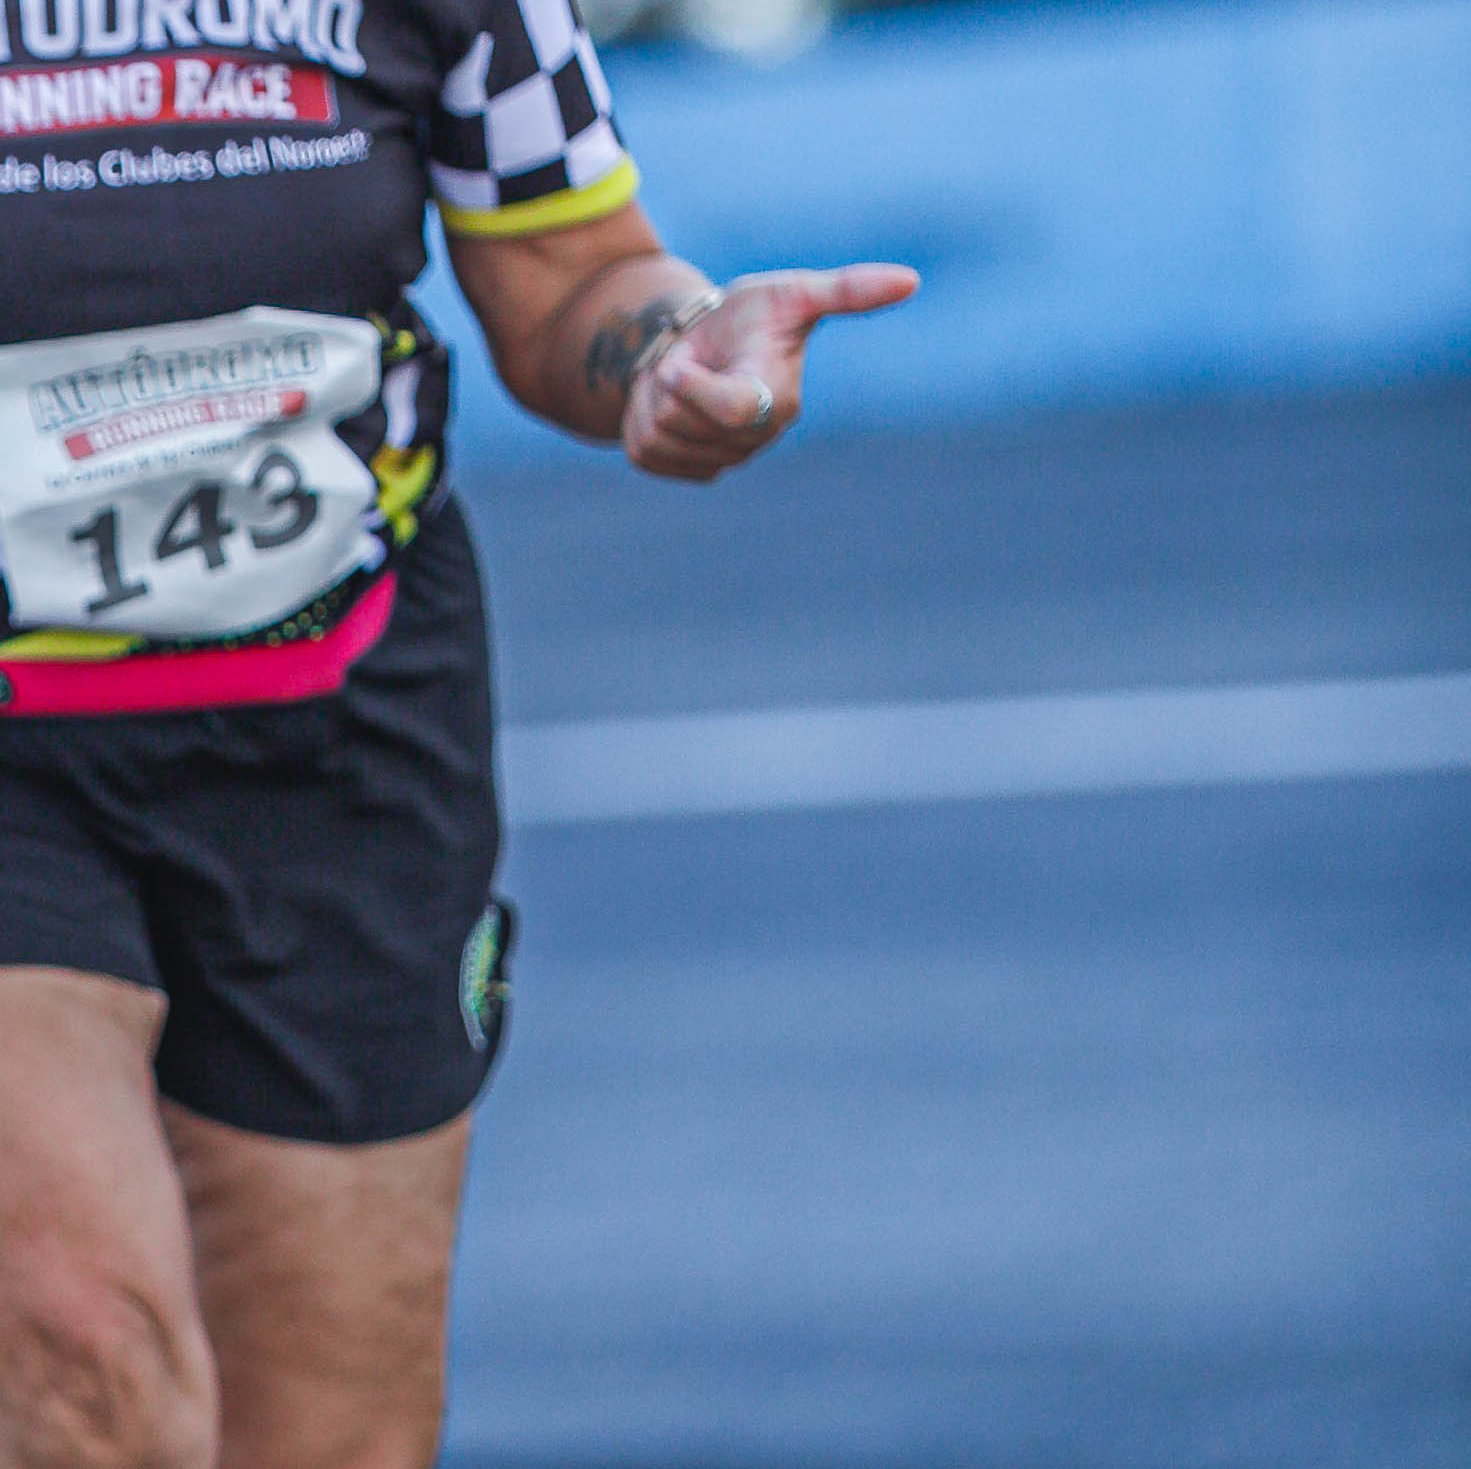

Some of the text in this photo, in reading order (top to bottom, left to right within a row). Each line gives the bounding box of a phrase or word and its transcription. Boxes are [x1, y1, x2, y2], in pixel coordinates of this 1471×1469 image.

[174, 59, 298, 121] RACE
[43, 152, 97, 192] los
[98, 145, 215, 187] Clubes
[216, 136, 270, 178] del
[70, 446, 320, 613] 143
